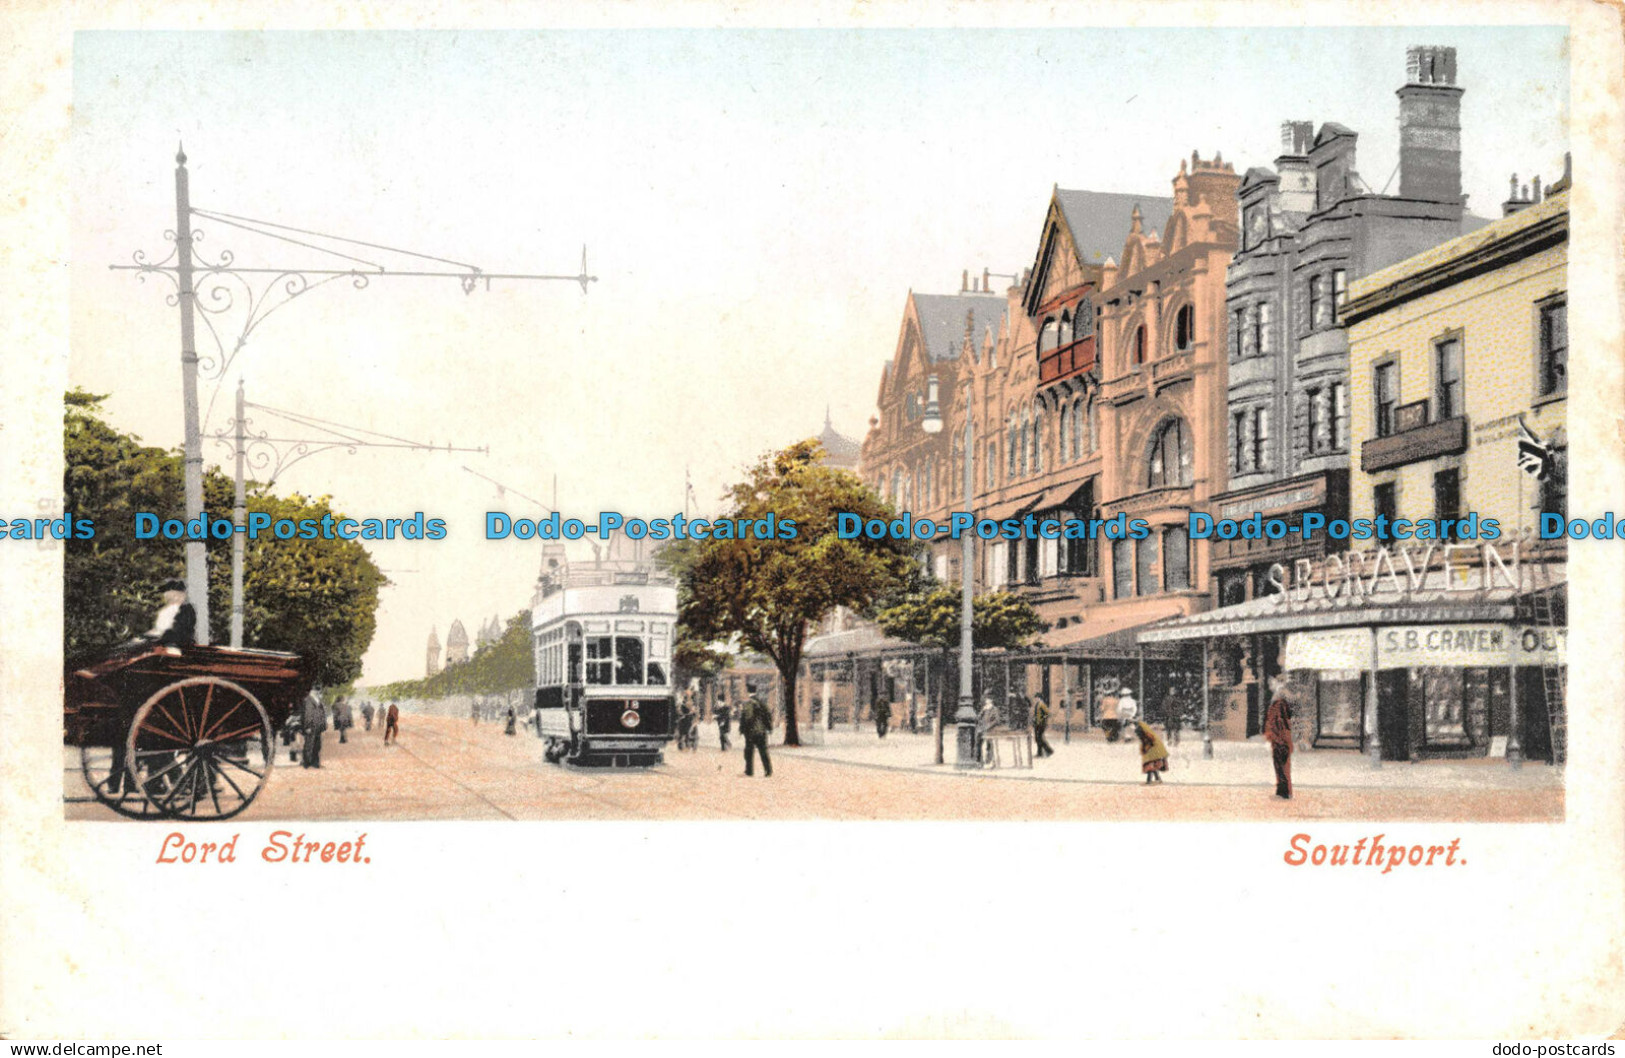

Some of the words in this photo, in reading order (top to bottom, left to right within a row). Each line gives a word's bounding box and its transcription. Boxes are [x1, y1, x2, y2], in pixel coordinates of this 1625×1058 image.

[1426, 630, 1504, 651] CRAVEN
[156, 832, 240, 864] Lord
[261, 830, 371, 864] Street.
[1283, 833, 1468, 875] Southport.
